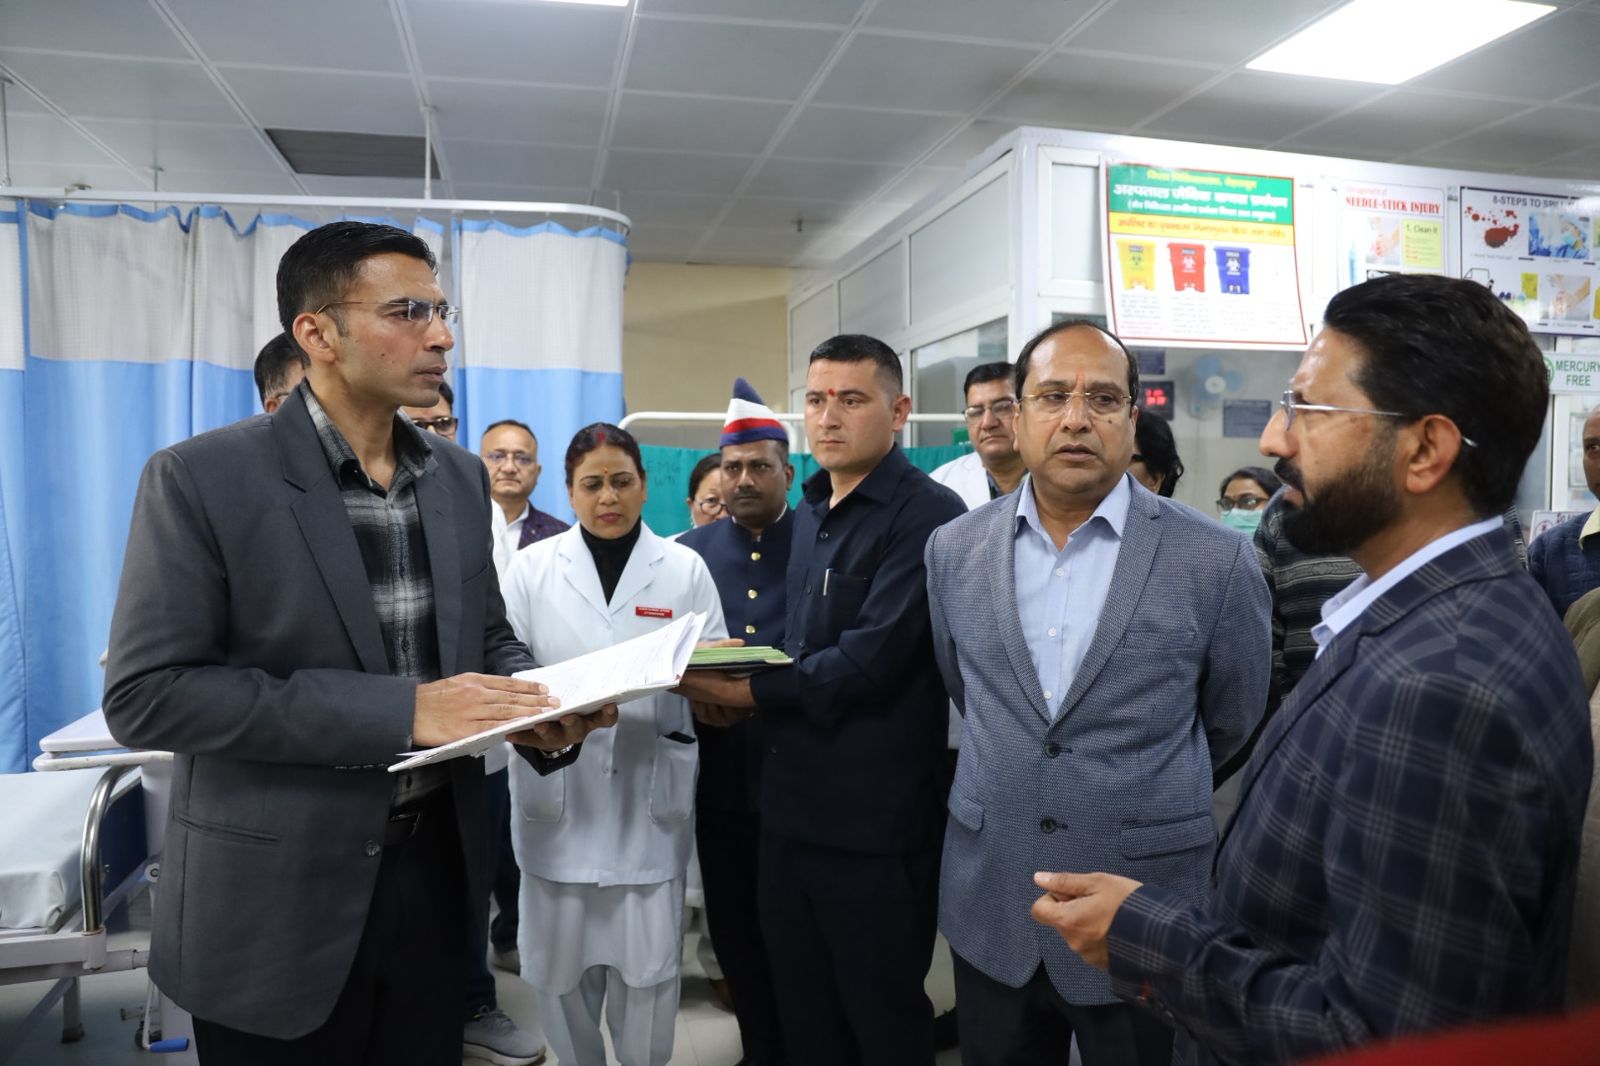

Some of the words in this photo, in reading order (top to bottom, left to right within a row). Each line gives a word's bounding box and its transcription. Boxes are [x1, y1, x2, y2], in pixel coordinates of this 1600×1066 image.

[1113, 183, 1170, 199] अस्पताल
[1346, 196, 1408, 212] NEEDLE-STICK
[1410, 202, 1441, 214] INJURY
[1493, 195, 1527, 207] 8-STEPS
[1530, 199, 1541, 208] TO
[1556, 360, 1600, 372] MERCURY
[1566, 375, 1591, 386] FREE
